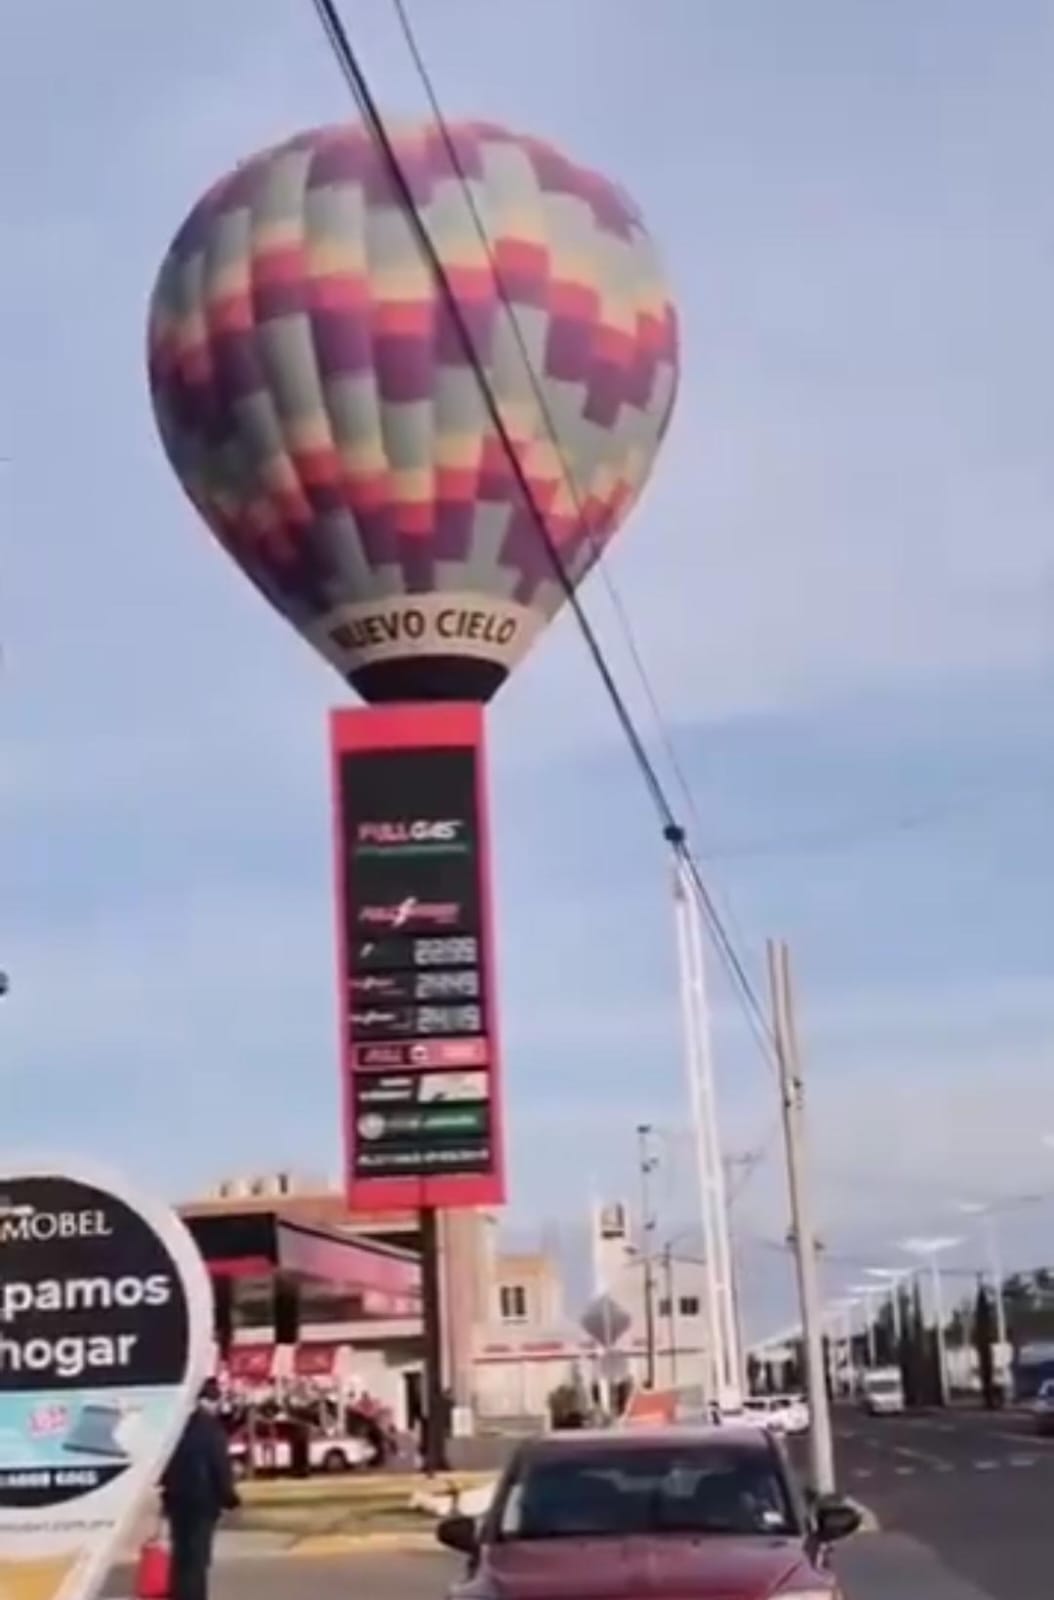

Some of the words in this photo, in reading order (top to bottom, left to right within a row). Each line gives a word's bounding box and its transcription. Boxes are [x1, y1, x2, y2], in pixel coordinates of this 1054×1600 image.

[436, 609, 516, 645] CIELO
[3, 1274, 171, 1322] pamos
[0, 1333, 137, 1377] hogar
